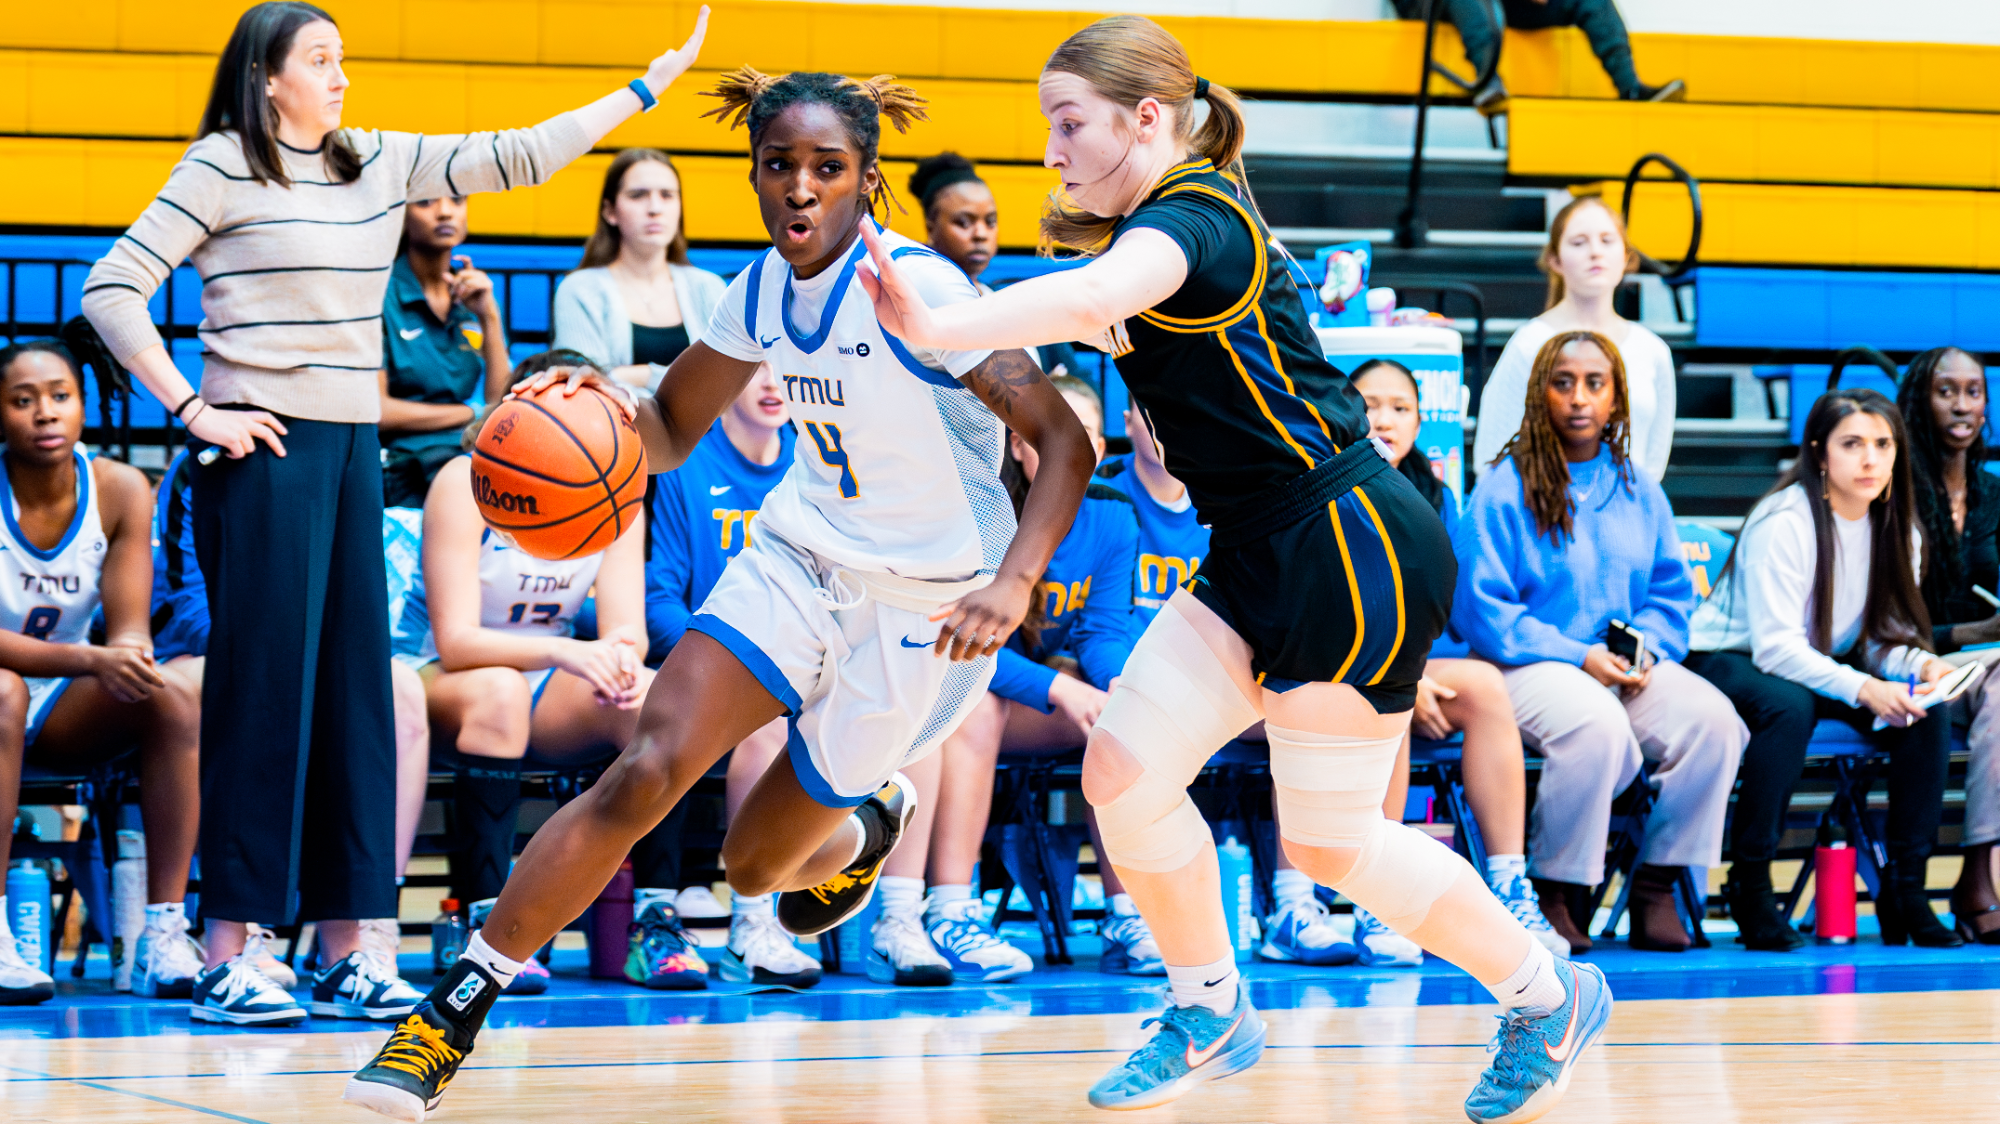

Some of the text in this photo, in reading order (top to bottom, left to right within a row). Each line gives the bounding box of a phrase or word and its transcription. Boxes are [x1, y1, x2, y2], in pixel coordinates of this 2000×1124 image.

[782, 373, 846, 407] TMU
[802, 419, 861, 499] 4
[471, 469, 540, 515] ilson
[19, 571, 80, 594] TMU
[518, 573, 576, 593] TMU
